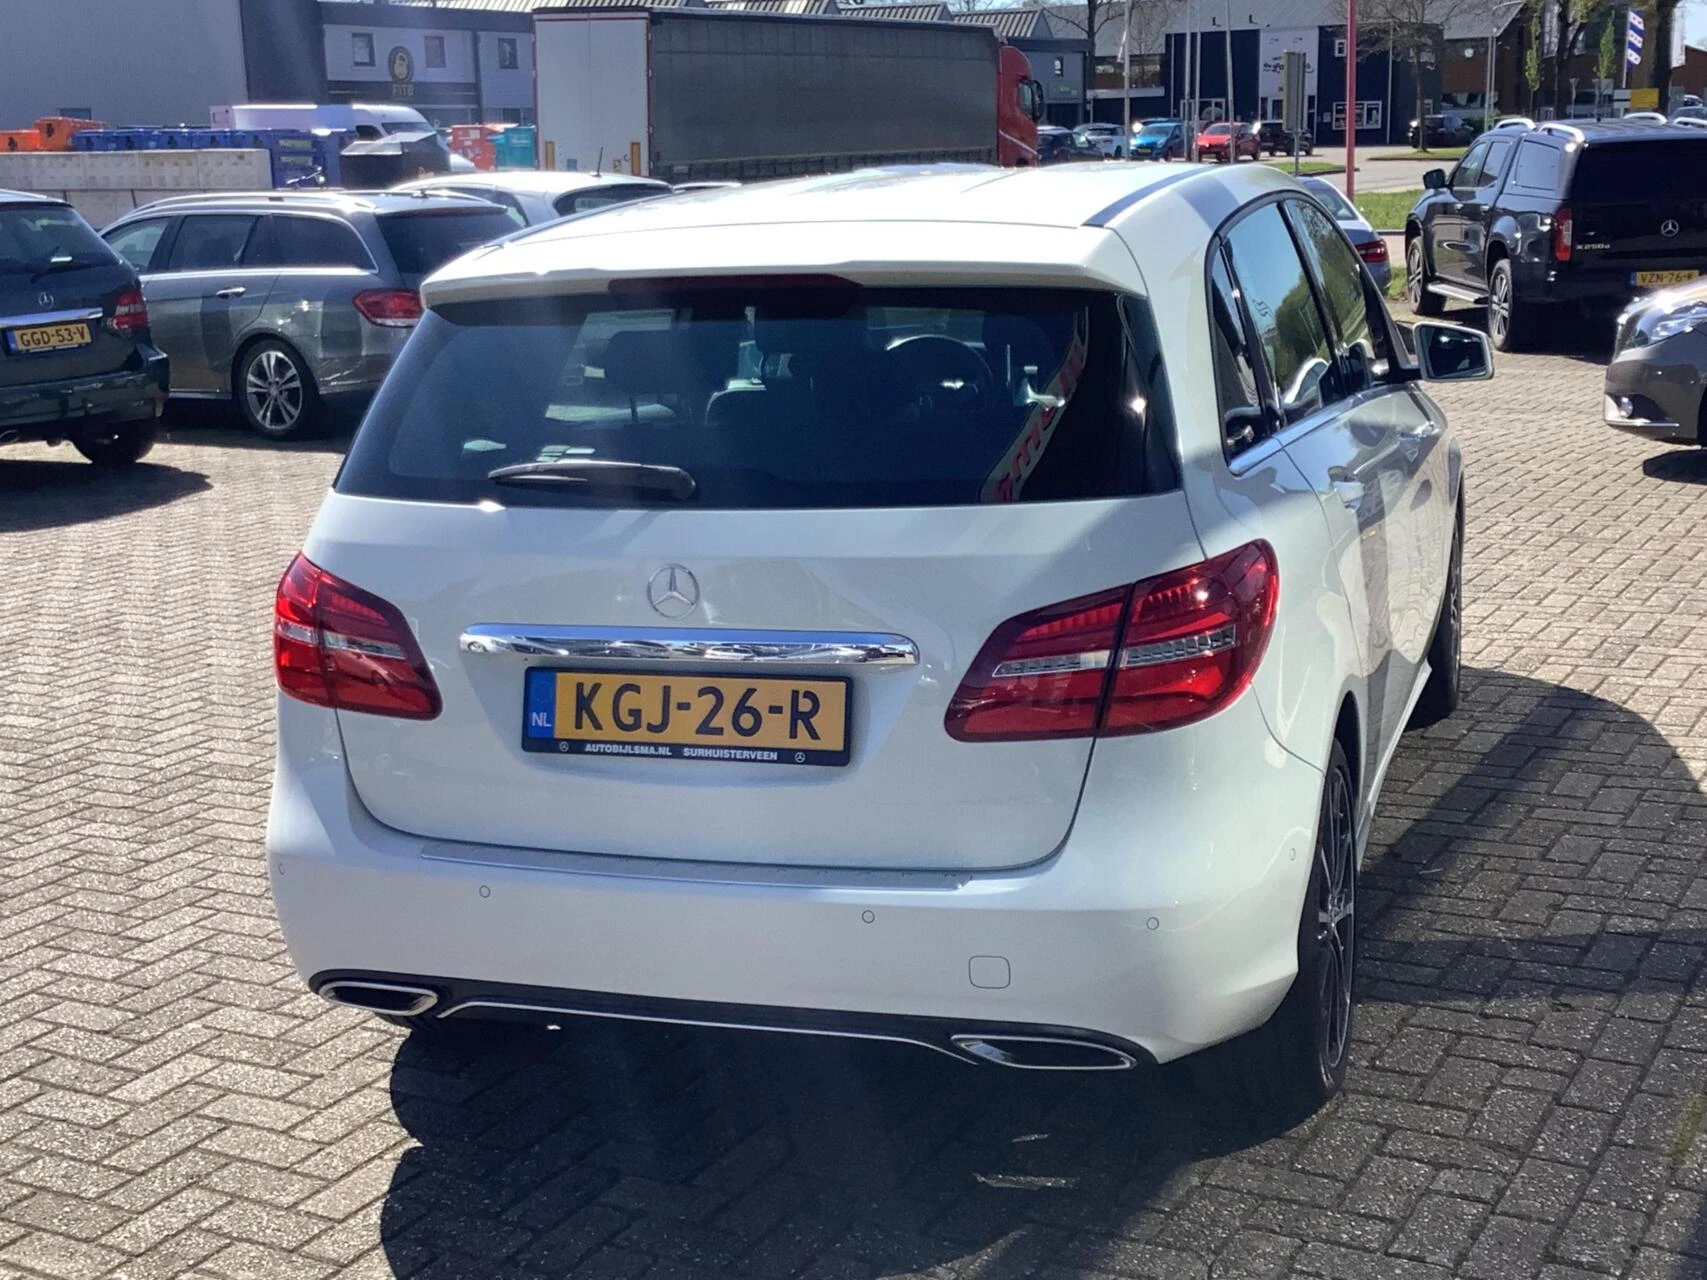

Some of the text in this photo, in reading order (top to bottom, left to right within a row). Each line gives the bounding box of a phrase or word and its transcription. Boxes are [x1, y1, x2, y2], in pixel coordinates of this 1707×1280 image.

[20, 325, 86, 347] GGD-53-V
[531, 712, 552, 728] NL
[575, 682, 821, 740] KGJ-26-R
[585, 743, 778, 761] AUTOBIJLSMA.NL SURHUISTERVEEN
